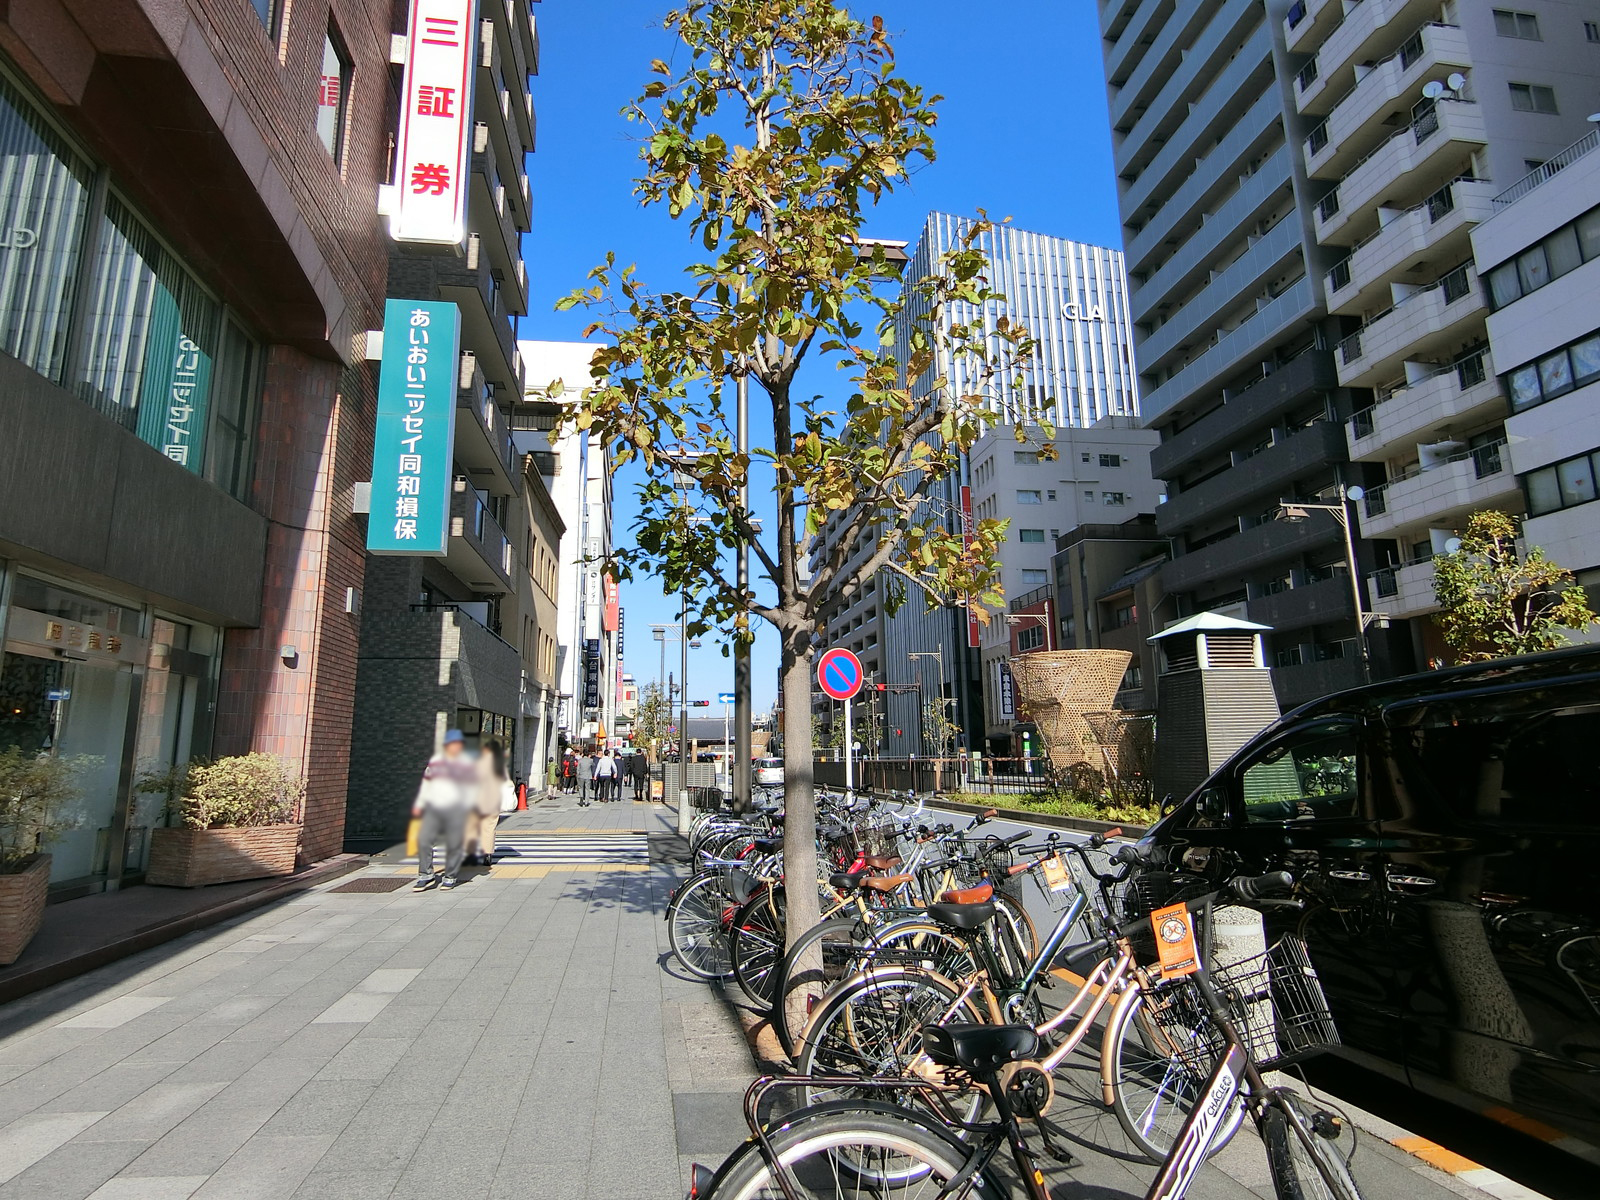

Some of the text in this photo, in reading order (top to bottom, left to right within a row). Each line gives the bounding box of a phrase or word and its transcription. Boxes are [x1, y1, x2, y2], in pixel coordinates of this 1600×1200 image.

[411, 17, 459, 196] 三証券
[1062, 302, 1104, 322] GLA
[394, 308, 431, 540] あいおいニッセイ同和損保
